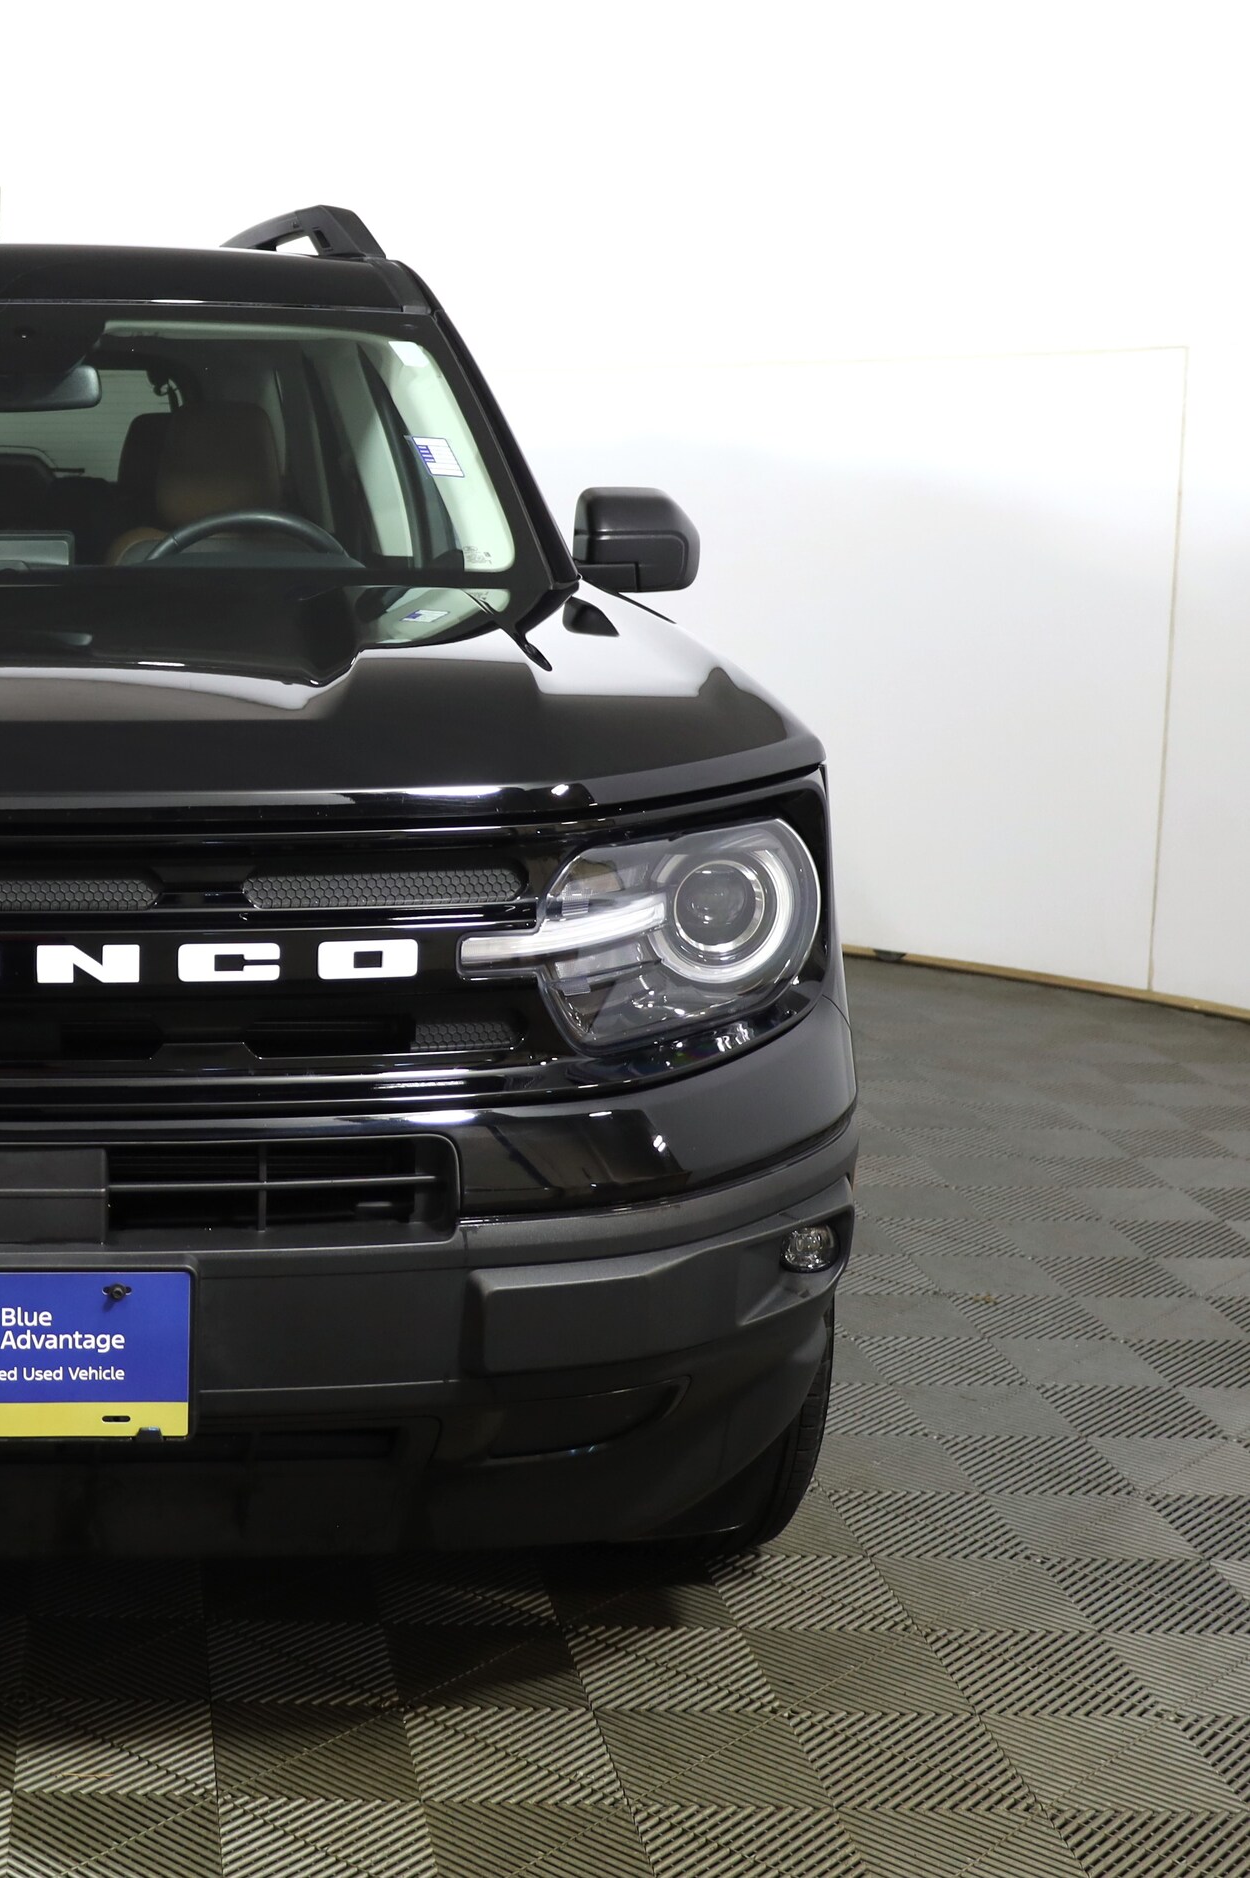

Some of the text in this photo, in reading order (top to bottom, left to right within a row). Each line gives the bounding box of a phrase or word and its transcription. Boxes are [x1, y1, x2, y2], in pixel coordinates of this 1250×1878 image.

[1, 1306, 53, 1327] Blue
[0, 1329, 125, 1353] Advantage
[23, 1366, 63, 1382] Used
[68, 1365, 125, 1381] Vehicle
